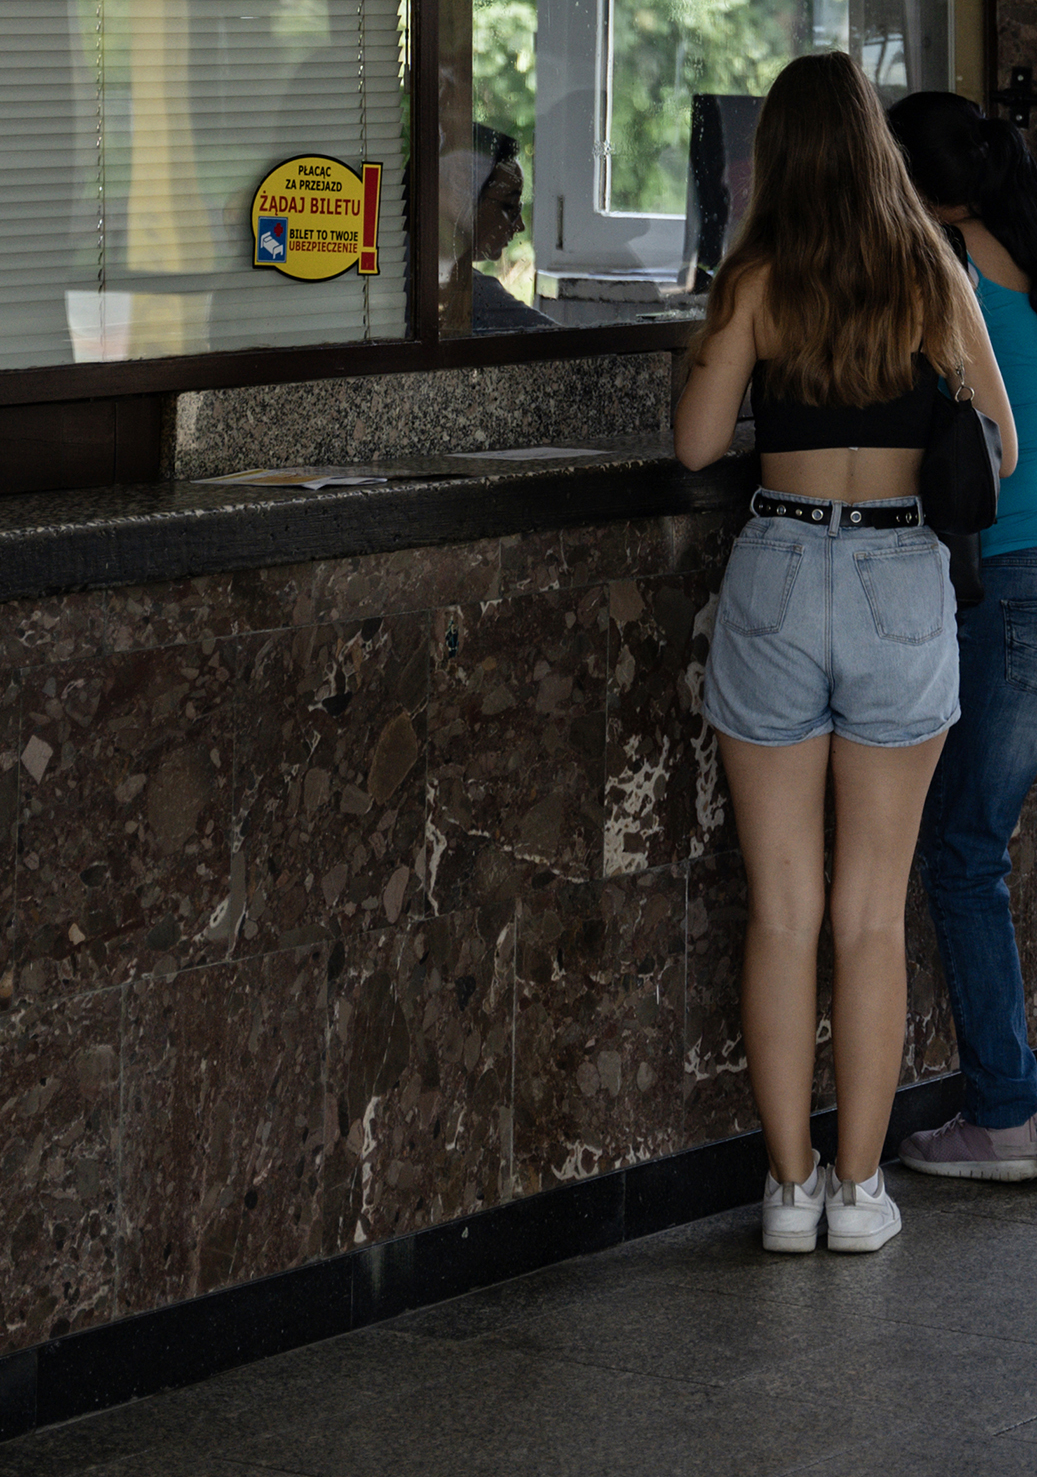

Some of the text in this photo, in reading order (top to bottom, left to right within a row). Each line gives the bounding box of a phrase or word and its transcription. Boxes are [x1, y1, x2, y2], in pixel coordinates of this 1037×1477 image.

[298, 165, 331, 179] PŁACĄC
[285, 179, 342, 192] ZA PRZEJAZD
[259, 190, 361, 216] ŻĄDAJ BILETU
[289, 229, 359, 242] BILET TO TWOJE
[289, 241, 358, 254] UBEZPIECZENIE
